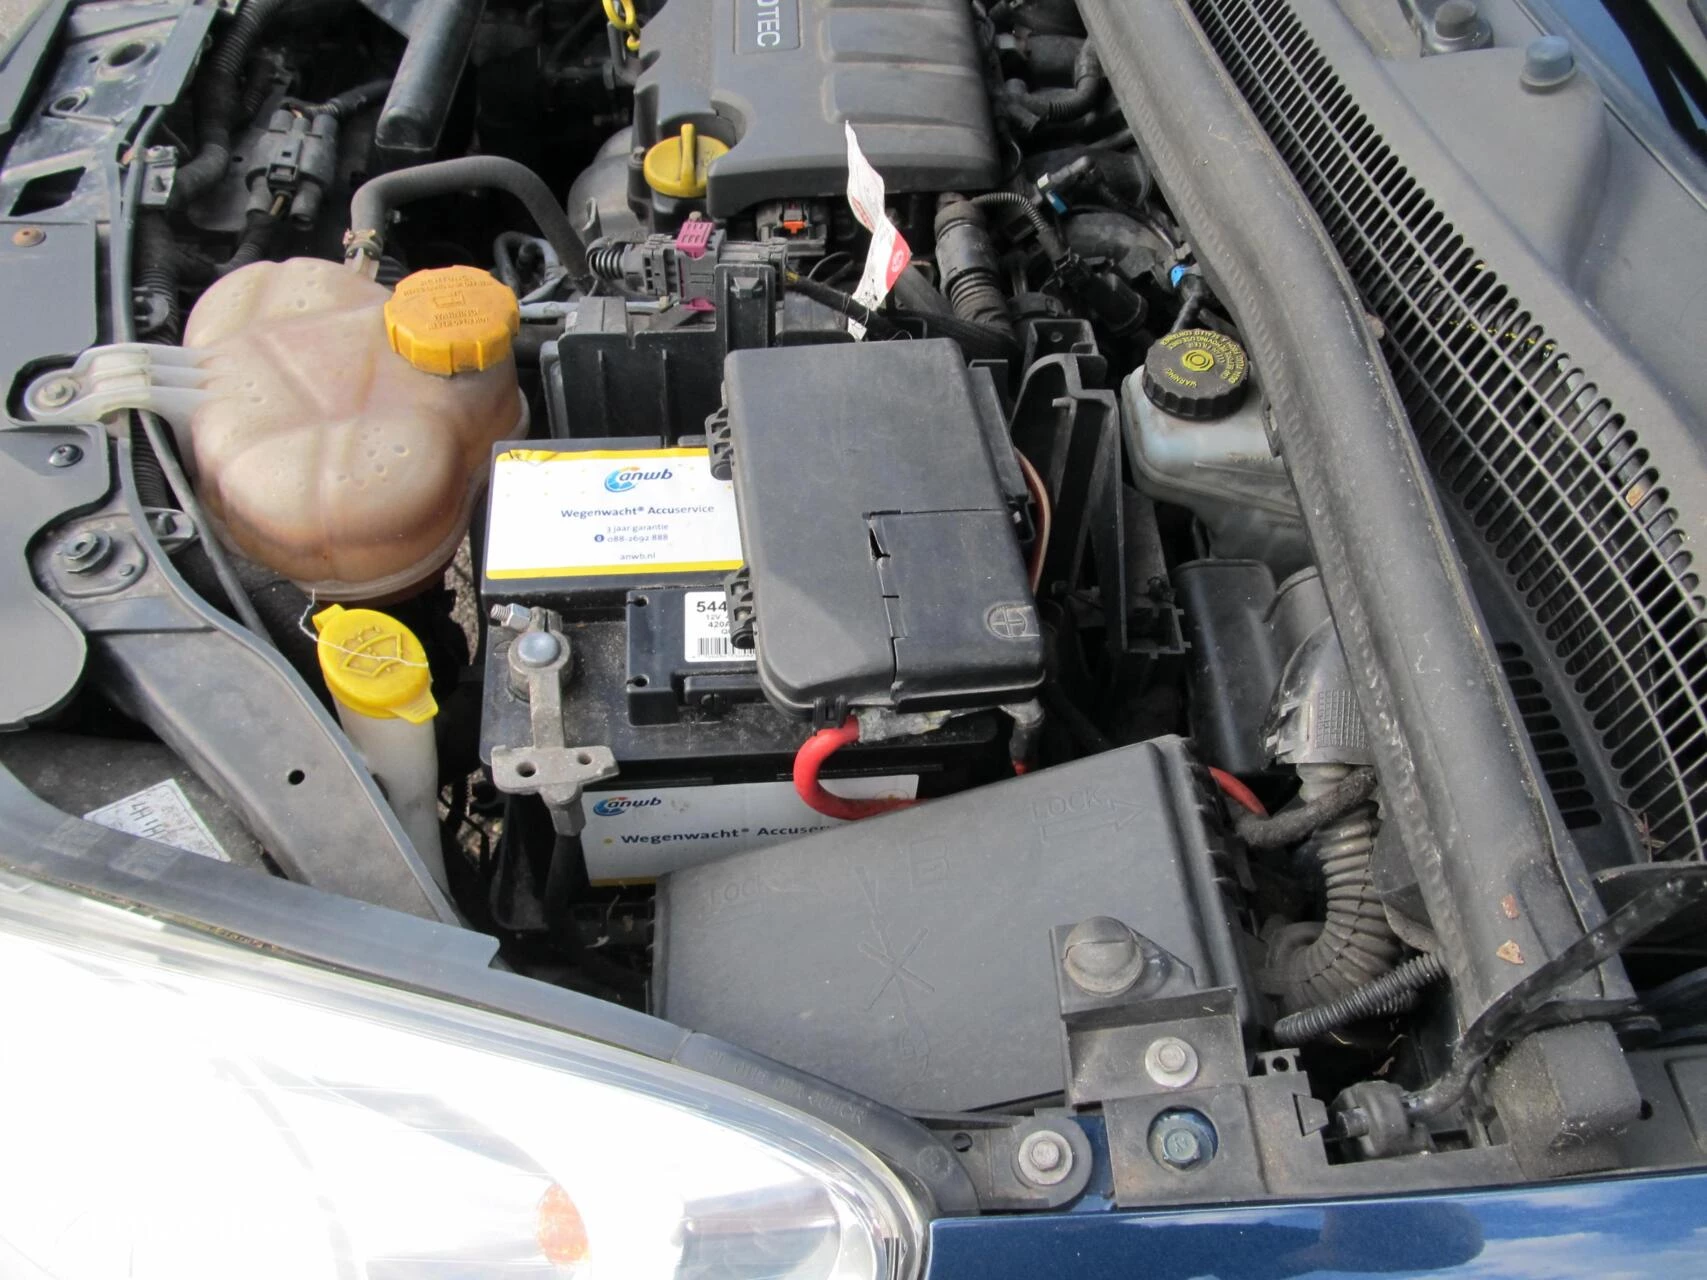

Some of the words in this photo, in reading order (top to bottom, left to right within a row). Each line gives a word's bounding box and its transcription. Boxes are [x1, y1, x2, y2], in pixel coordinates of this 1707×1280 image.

[619, 468, 673, 482] anwb
[648, 505, 715, 515] Accuservice
[632, 523, 669, 533] garantie
[620, 552, 656, 561] anwb.nl
[607, 797, 662, 808] anwb
